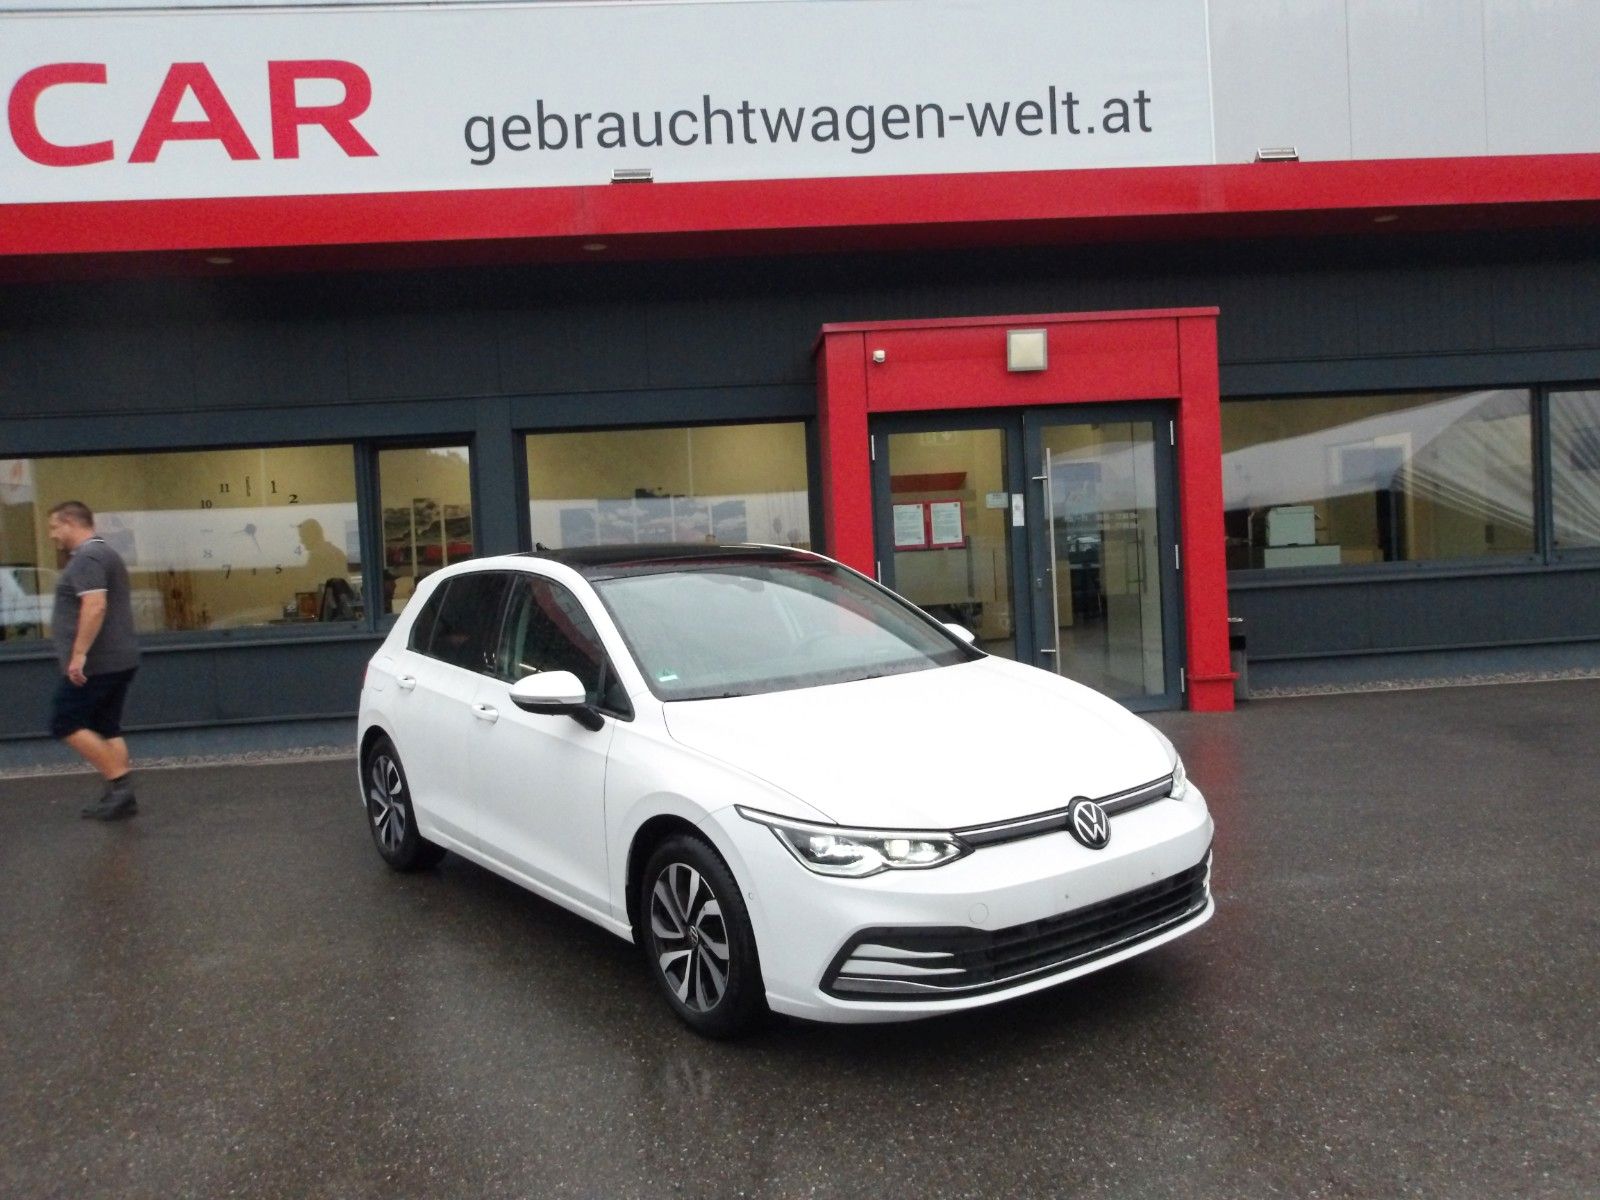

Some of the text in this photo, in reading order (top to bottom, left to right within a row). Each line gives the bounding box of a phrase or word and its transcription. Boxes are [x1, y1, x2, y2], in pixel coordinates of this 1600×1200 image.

[8, 59, 378, 168] CAR
[464, 86, 1153, 165] gebrauchtwagen-welt.at
[289, 494, 298, 504] 2
[1075, 802, 1108, 843] VW
